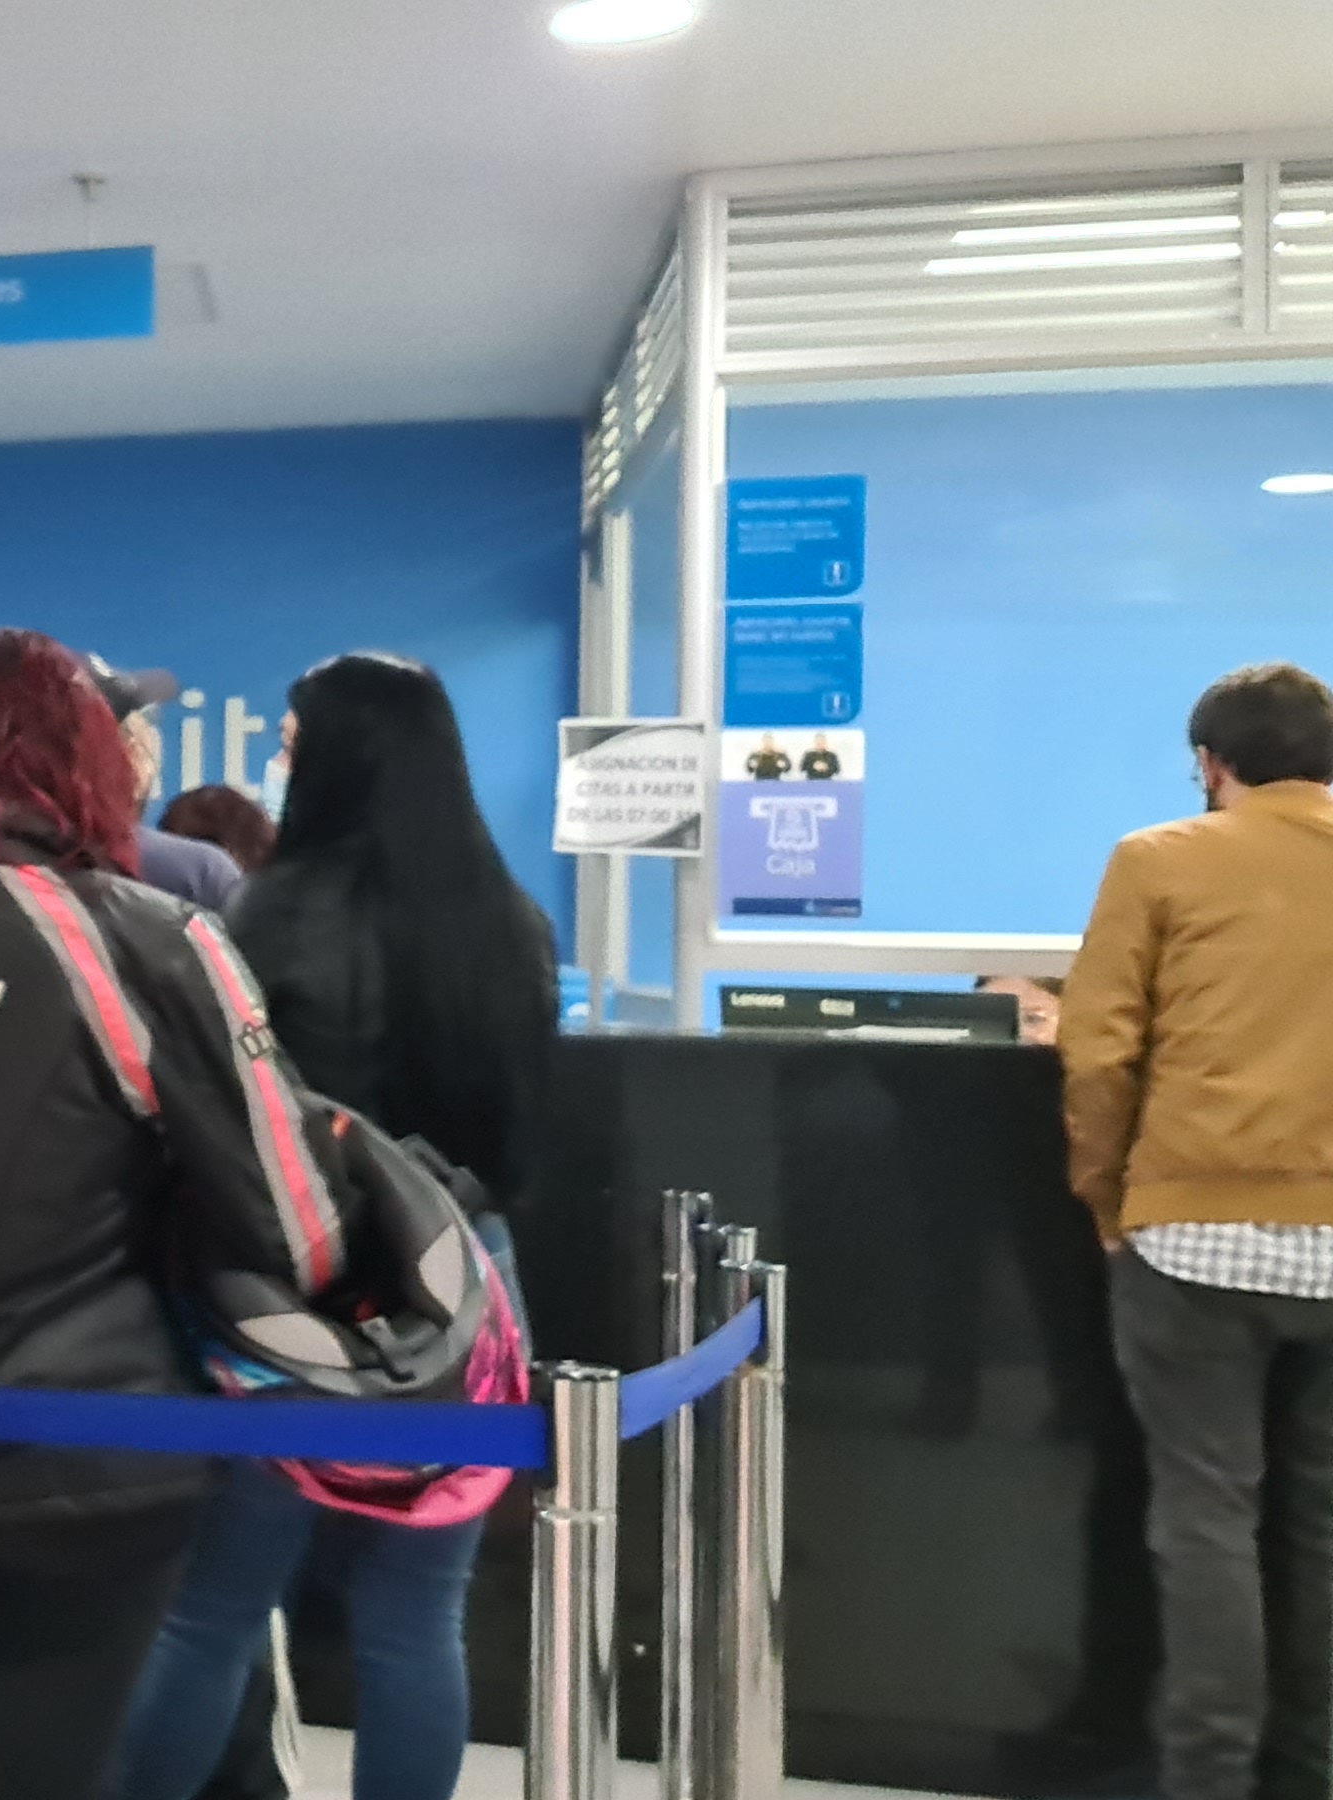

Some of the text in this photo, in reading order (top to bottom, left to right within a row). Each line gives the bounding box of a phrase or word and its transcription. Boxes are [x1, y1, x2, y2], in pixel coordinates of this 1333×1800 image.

[626, 782, 637, 796] A
[642, 782, 695, 797] PARTIR
[765, 853, 817, 879] Caja
